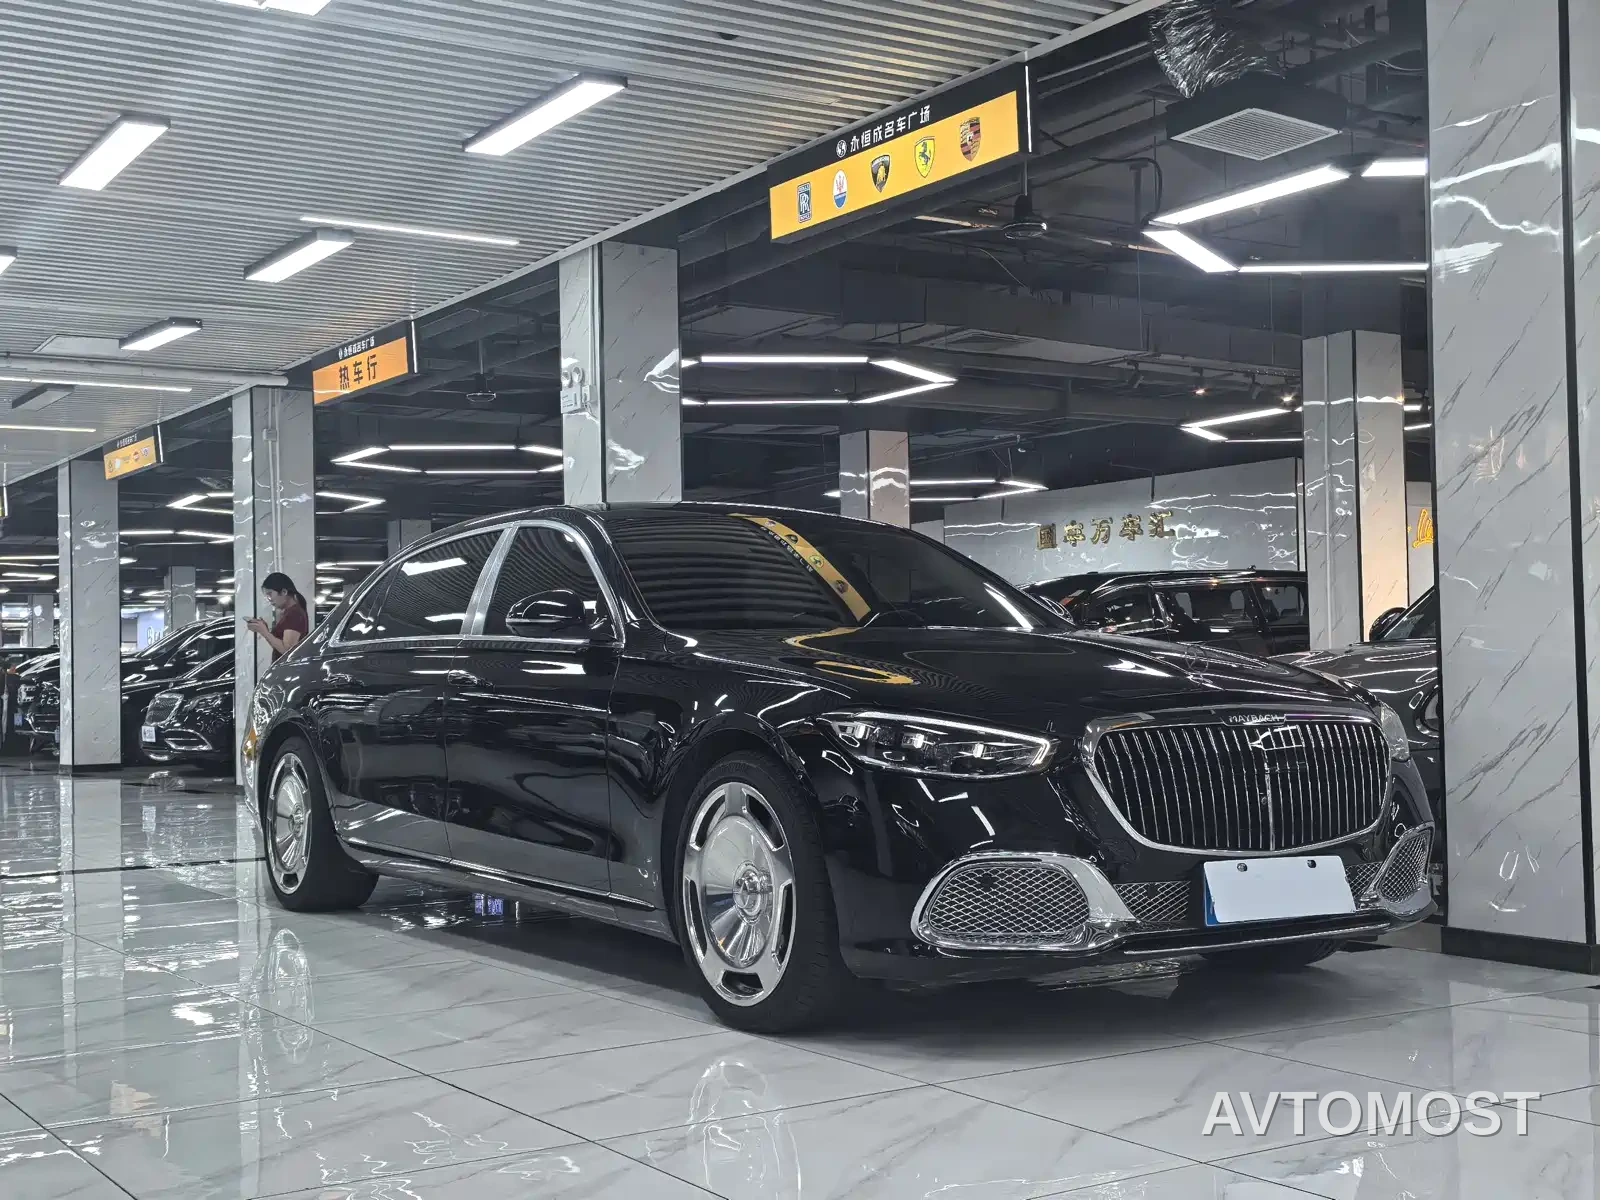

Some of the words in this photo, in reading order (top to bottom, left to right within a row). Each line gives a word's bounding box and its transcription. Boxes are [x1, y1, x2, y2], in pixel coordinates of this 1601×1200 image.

[850, 104, 931, 153] 永恒成名车广场
[338, 354, 378, 391] 热车行
